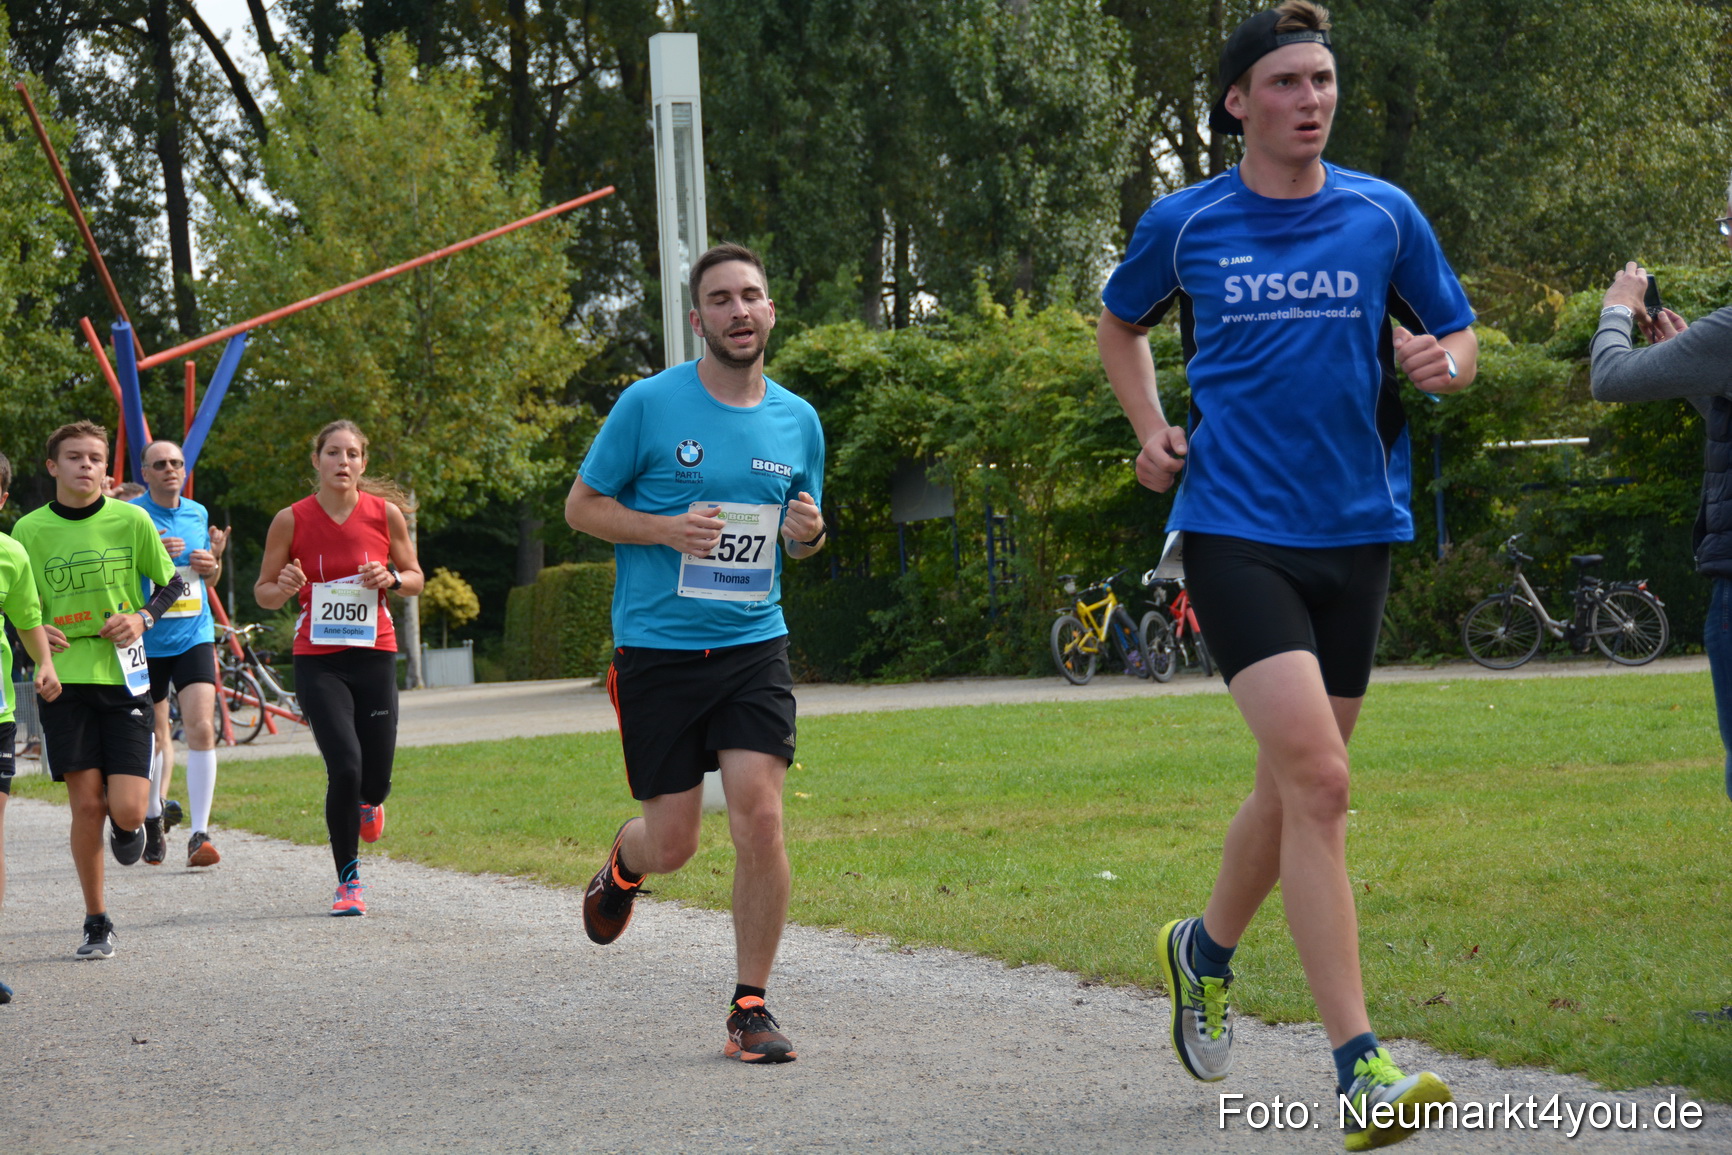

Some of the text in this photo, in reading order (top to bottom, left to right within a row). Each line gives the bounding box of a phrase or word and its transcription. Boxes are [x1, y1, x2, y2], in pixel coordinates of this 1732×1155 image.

[1230, 255, 1253, 265] JAKO
[1224, 270, 1359, 304] SYSCAD
[1221, 306, 1362, 324] www.metallbau-cad.de
[678, 440, 702, 450] BMW
[675, 471, 704, 479] PARTL
[752, 458, 792, 478] BOCK
[728, 513, 760, 522] BOCK
[698, 534, 766, 563] 527
[44, 546, 132, 592] OPF
[713, 571, 751, 584] Thomas
[53, 610, 92, 626] MERZ
[321, 602, 368, 622] 2050
[323, 626, 365, 636] Anne-Sophie
